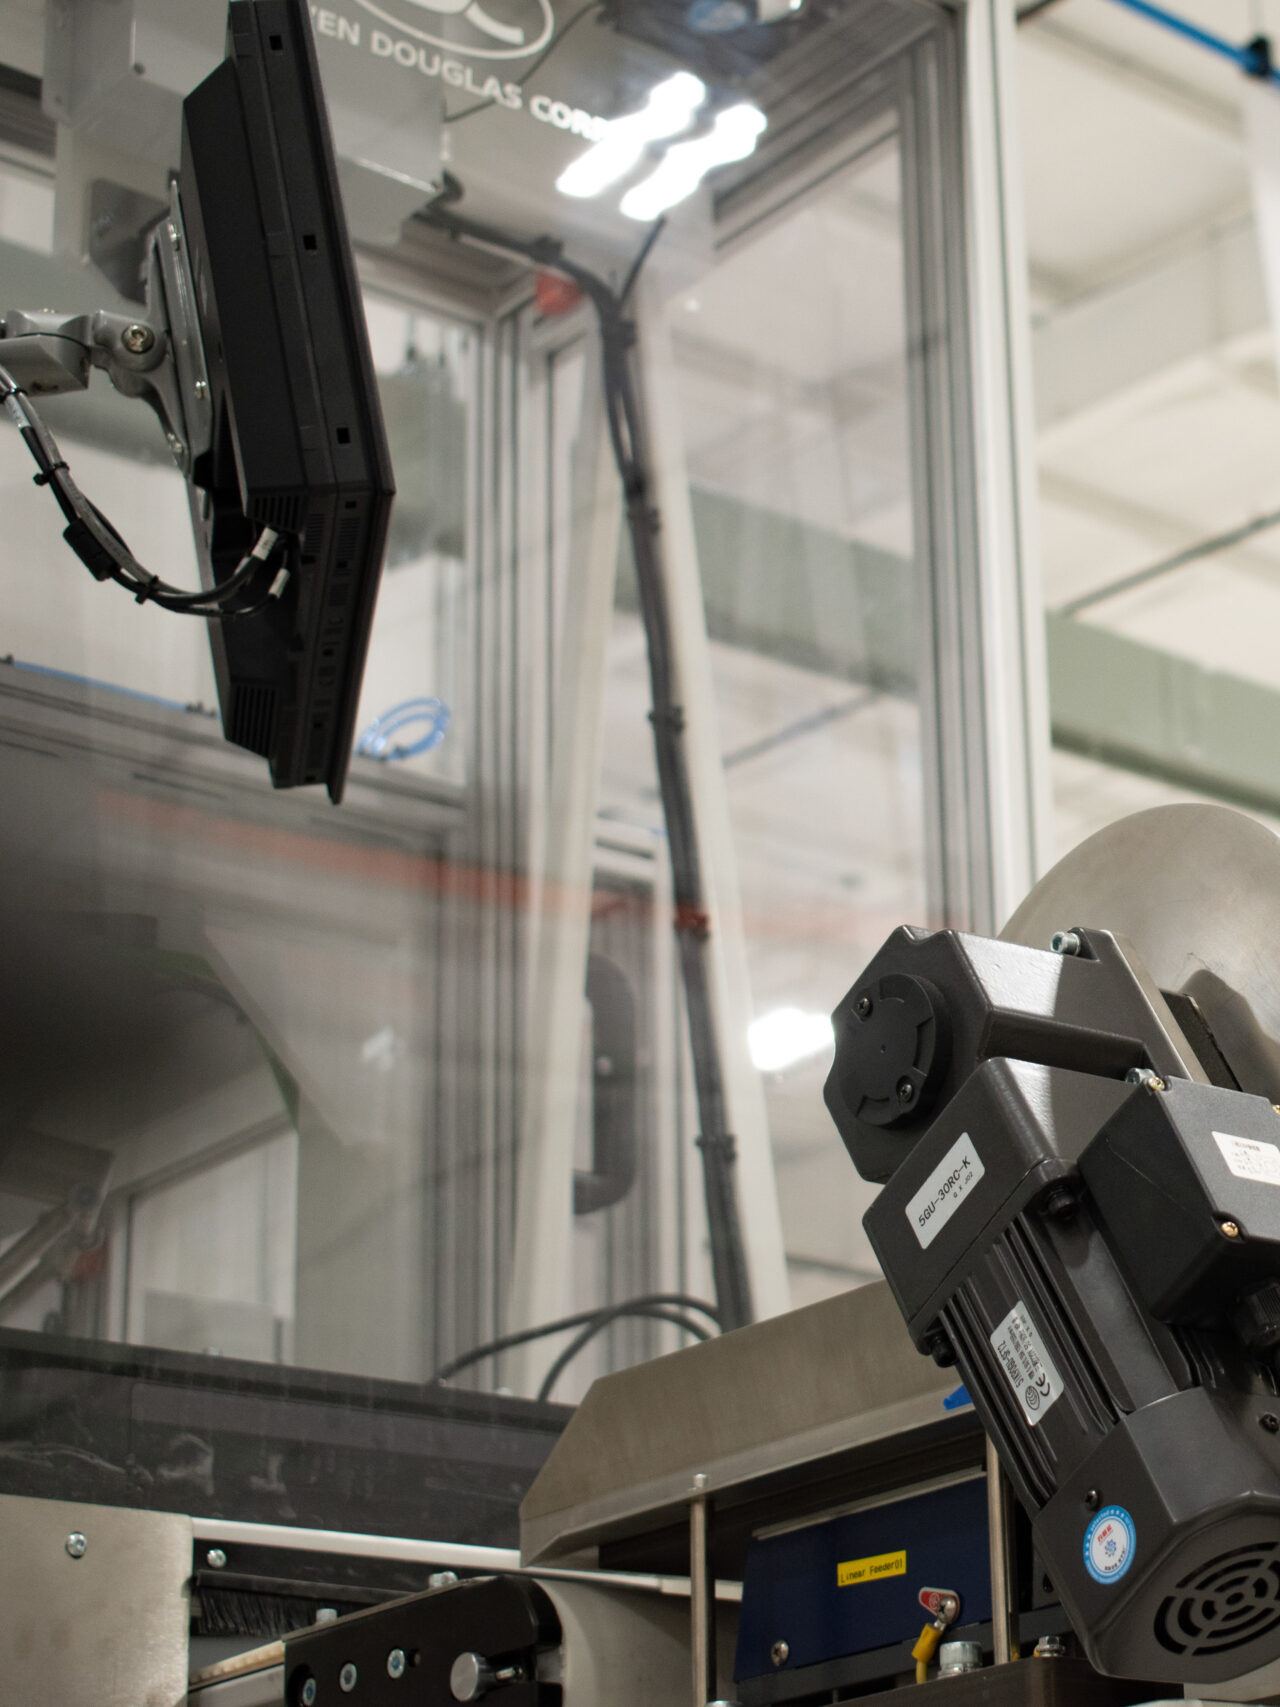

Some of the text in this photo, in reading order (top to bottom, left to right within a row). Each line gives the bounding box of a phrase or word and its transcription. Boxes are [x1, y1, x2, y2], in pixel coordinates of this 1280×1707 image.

[369, 30, 524, 110] DOUGLAS
[918, 1156, 971, 1227] 5GU-30RC-K
[840, 1568, 866, 1585] Linear
